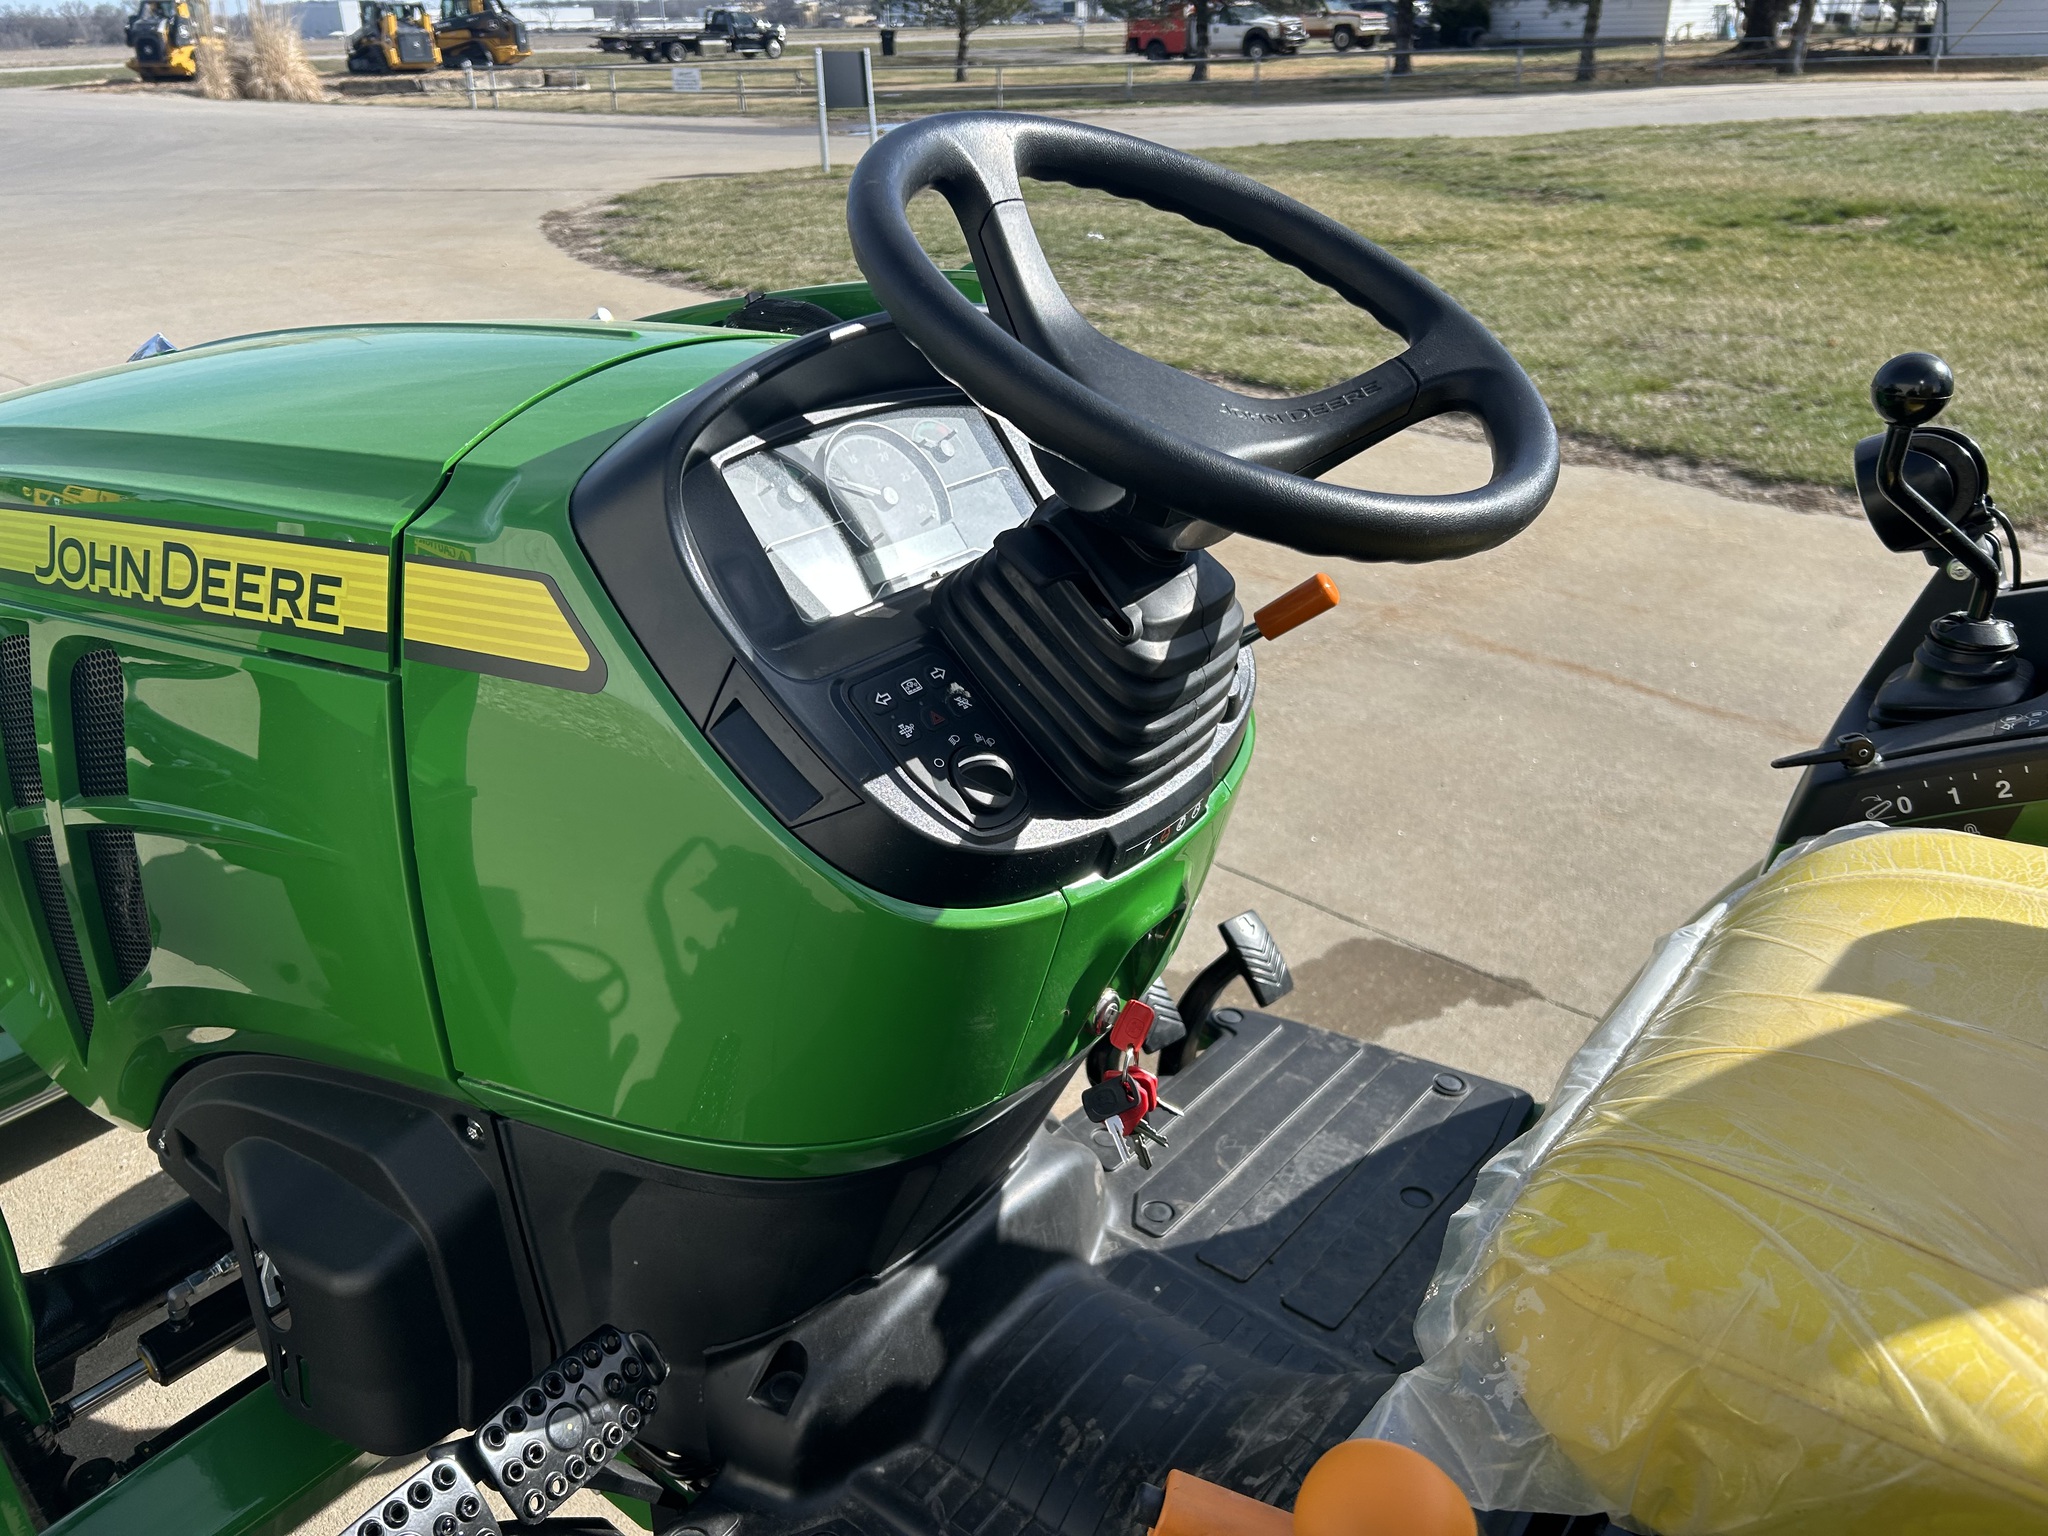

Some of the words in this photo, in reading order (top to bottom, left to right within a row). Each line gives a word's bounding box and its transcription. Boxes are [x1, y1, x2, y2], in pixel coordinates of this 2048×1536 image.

[1219, 402, 1284, 424] JOHN
[1285, 380, 1382, 423] DEERE
[35, 525, 150, 596] JOHN
[161, 541, 343, 626] DEERE
[1896, 796, 1913, 814] 0
[1947, 787, 1960, 805] 1
[1995, 780, 2013, 799] 2
